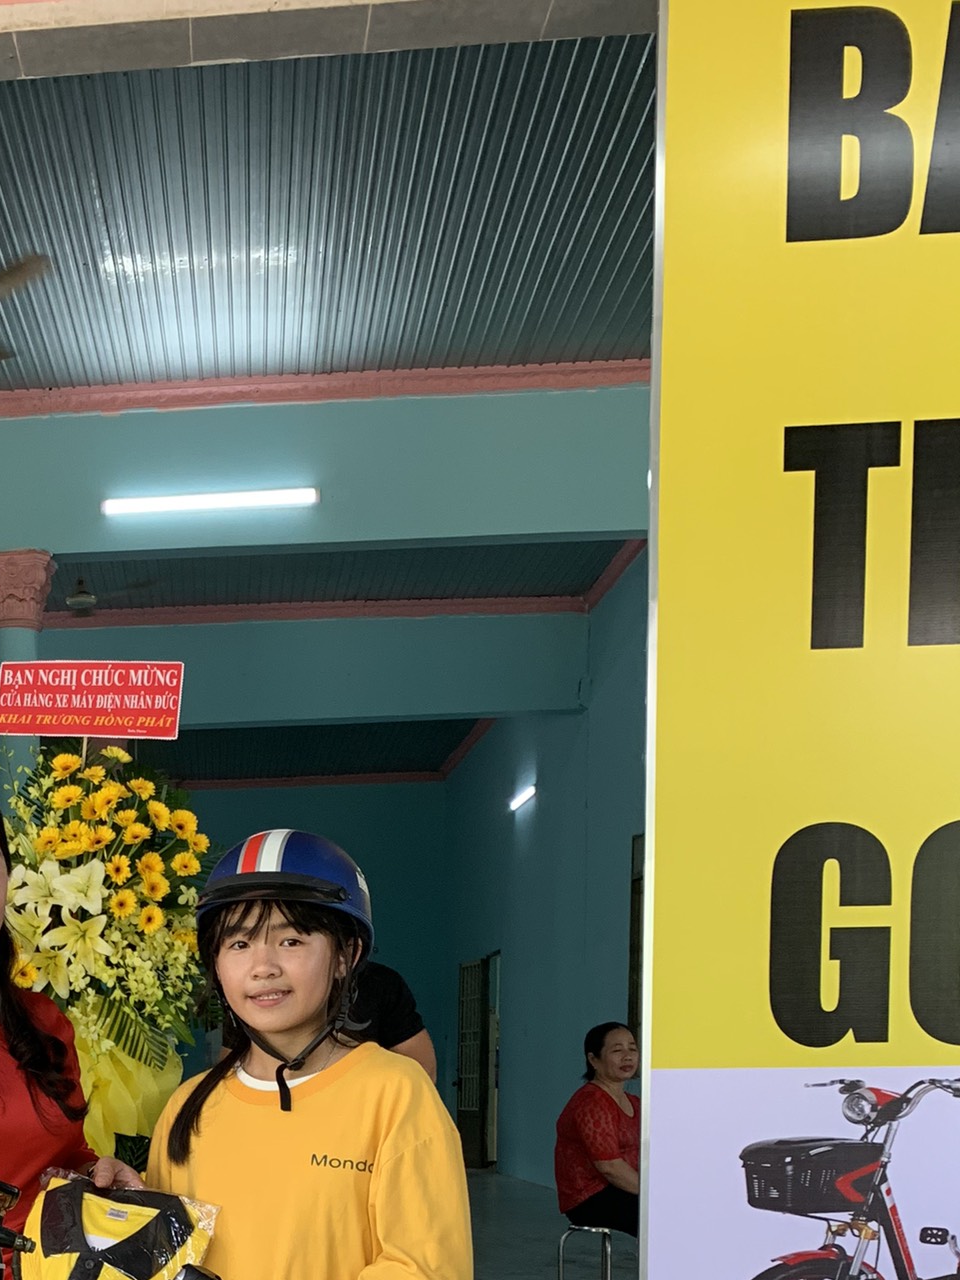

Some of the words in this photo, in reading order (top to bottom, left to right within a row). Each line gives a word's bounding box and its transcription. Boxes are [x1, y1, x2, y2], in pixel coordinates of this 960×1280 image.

[3, 669, 34, 689] BẠN
[37, 668, 77, 690] NGHỊ
[81, 665, 125, 687] CHÚC
[129, 665, 178, 687] MỪNG
[0, 689, 22, 707] CỬA
[23, 689, 54, 708] HÀNG
[55, 694, 69, 708] XE
[71, 690, 93, 708] MÁY
[95, 693, 121, 712] ĐIỆN
[123, 691, 154, 710] NHÂN
[154, 691, 178, 711] ĐỨC
[35, 712, 91, 726] TRƯƠNG
[135, 714, 175, 728] PHÁT
